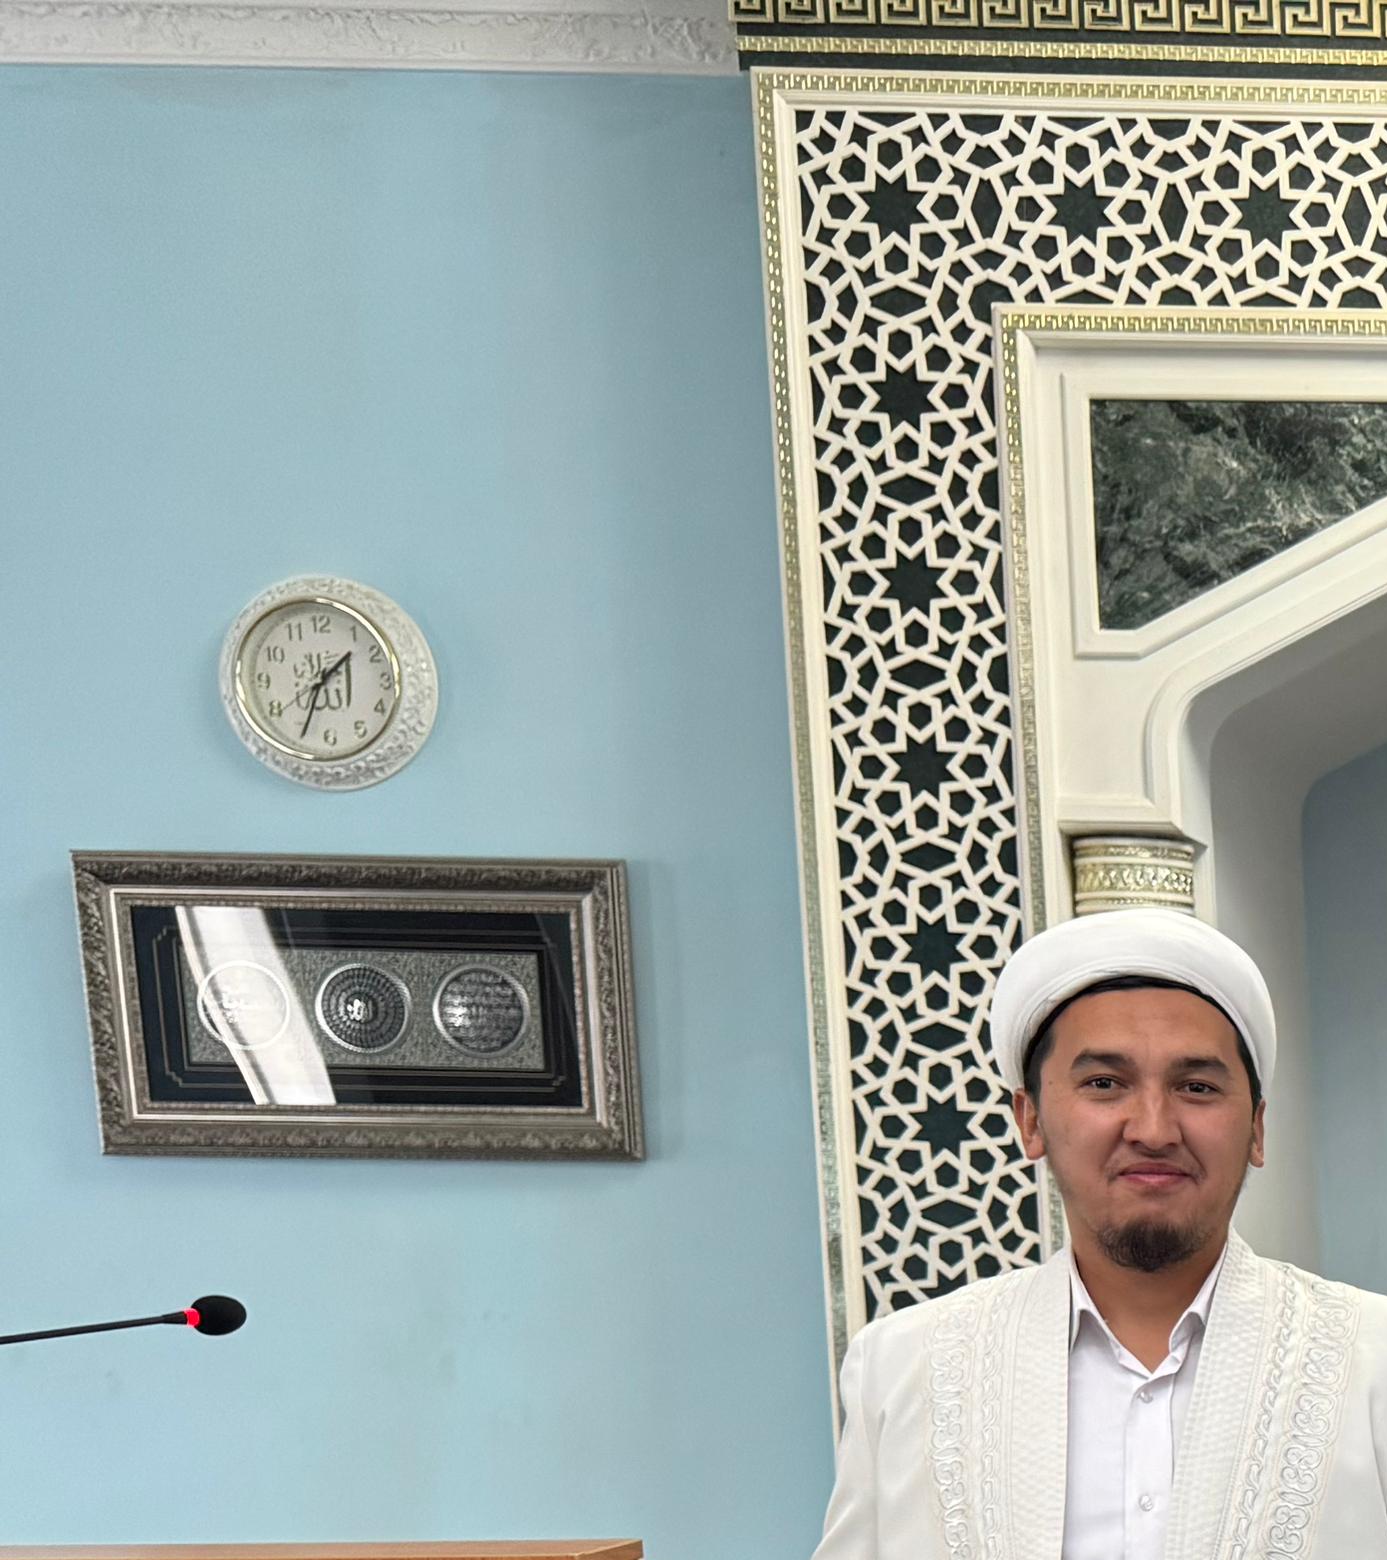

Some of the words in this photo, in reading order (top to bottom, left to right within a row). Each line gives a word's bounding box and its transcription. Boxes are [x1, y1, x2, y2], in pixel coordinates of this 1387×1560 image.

[286, 622, 303, 641] 11
[312, 616, 331, 633] 12
[350, 626, 358, 643] 1
[267, 646, 285, 663] 10
[369, 645, 383, 663] 2
[256, 672, 270, 690] 9
[380, 673, 393, 691] 3
[269, 700, 283, 718] 8
[374, 699, 386, 715] 4
